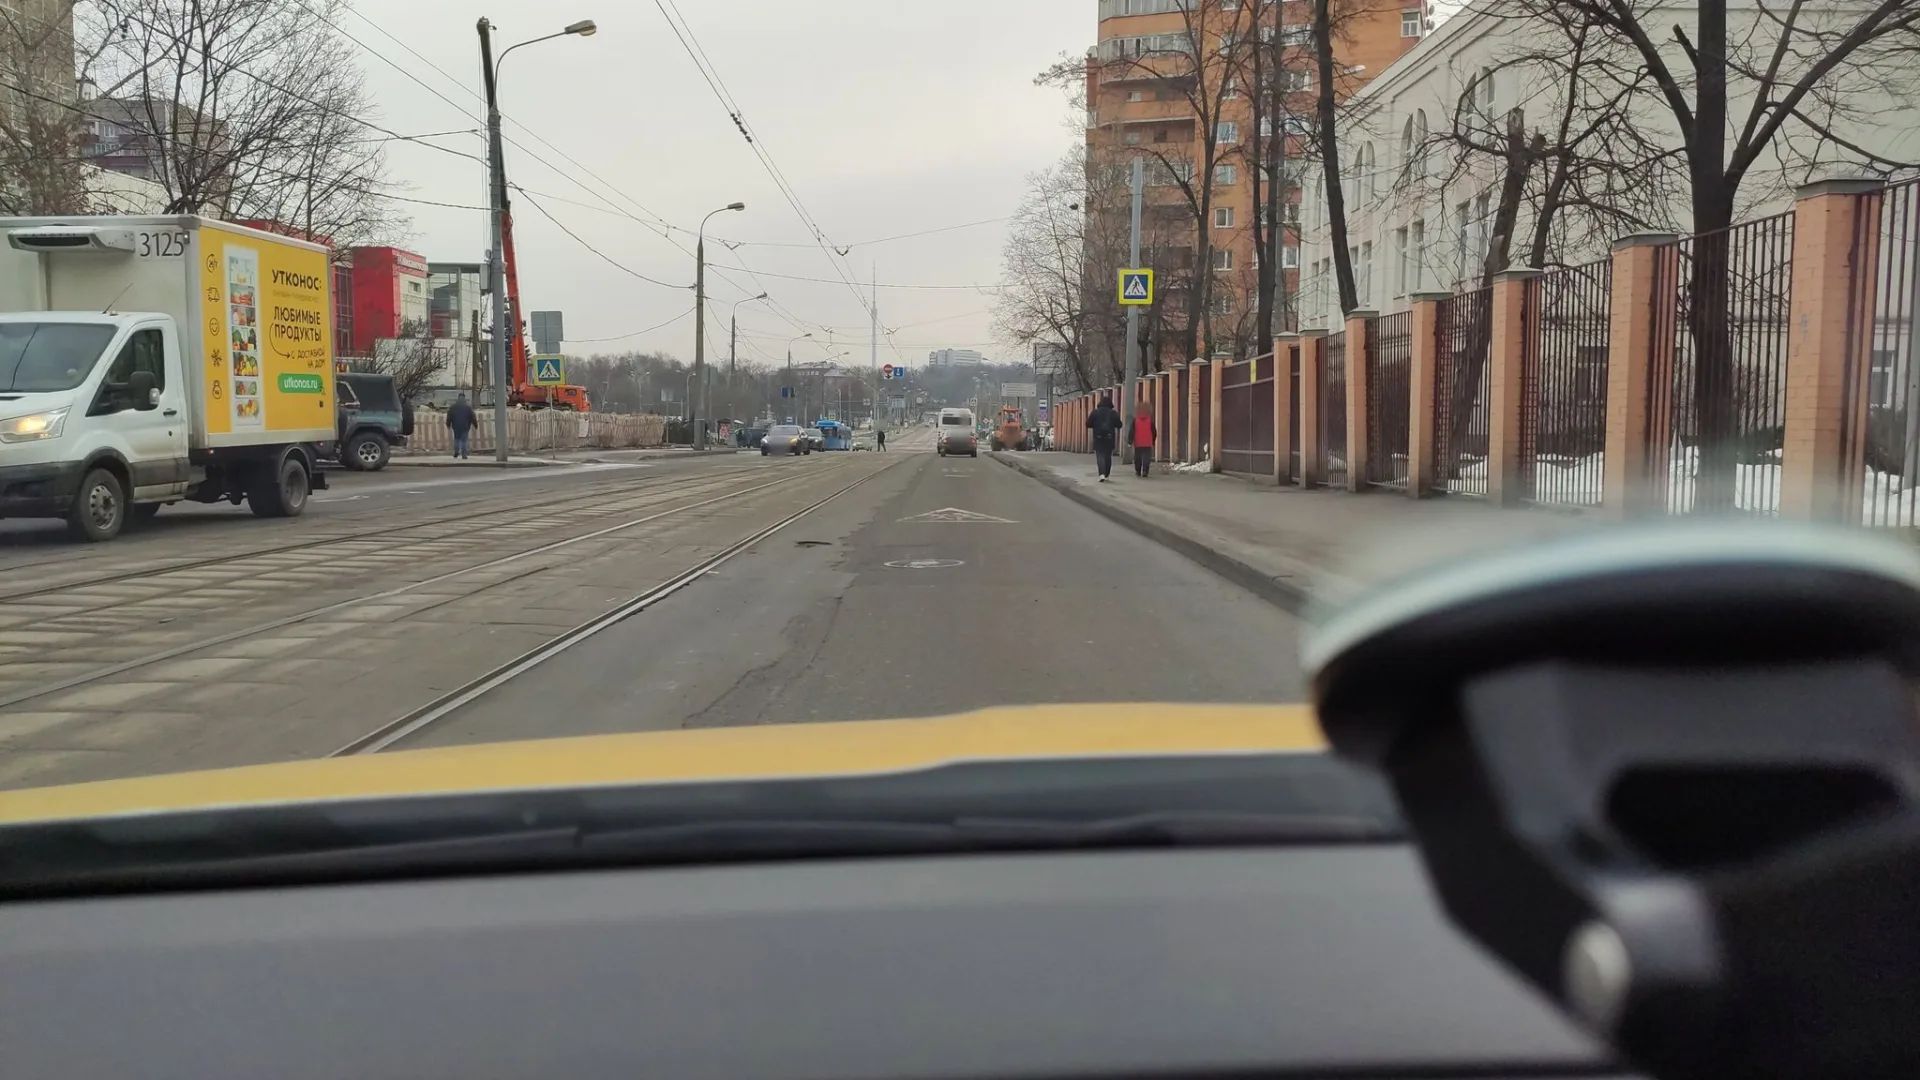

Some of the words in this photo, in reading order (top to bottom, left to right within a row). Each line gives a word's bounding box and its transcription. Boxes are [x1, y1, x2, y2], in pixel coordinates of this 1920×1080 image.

[139, 232, 184, 257] 3125
[273, 306, 321, 325] ЛЮБИМЫЕ
[274, 324, 322, 342] ПРОДУКТЫ
[283, 377, 318, 389] utkonos.ru
